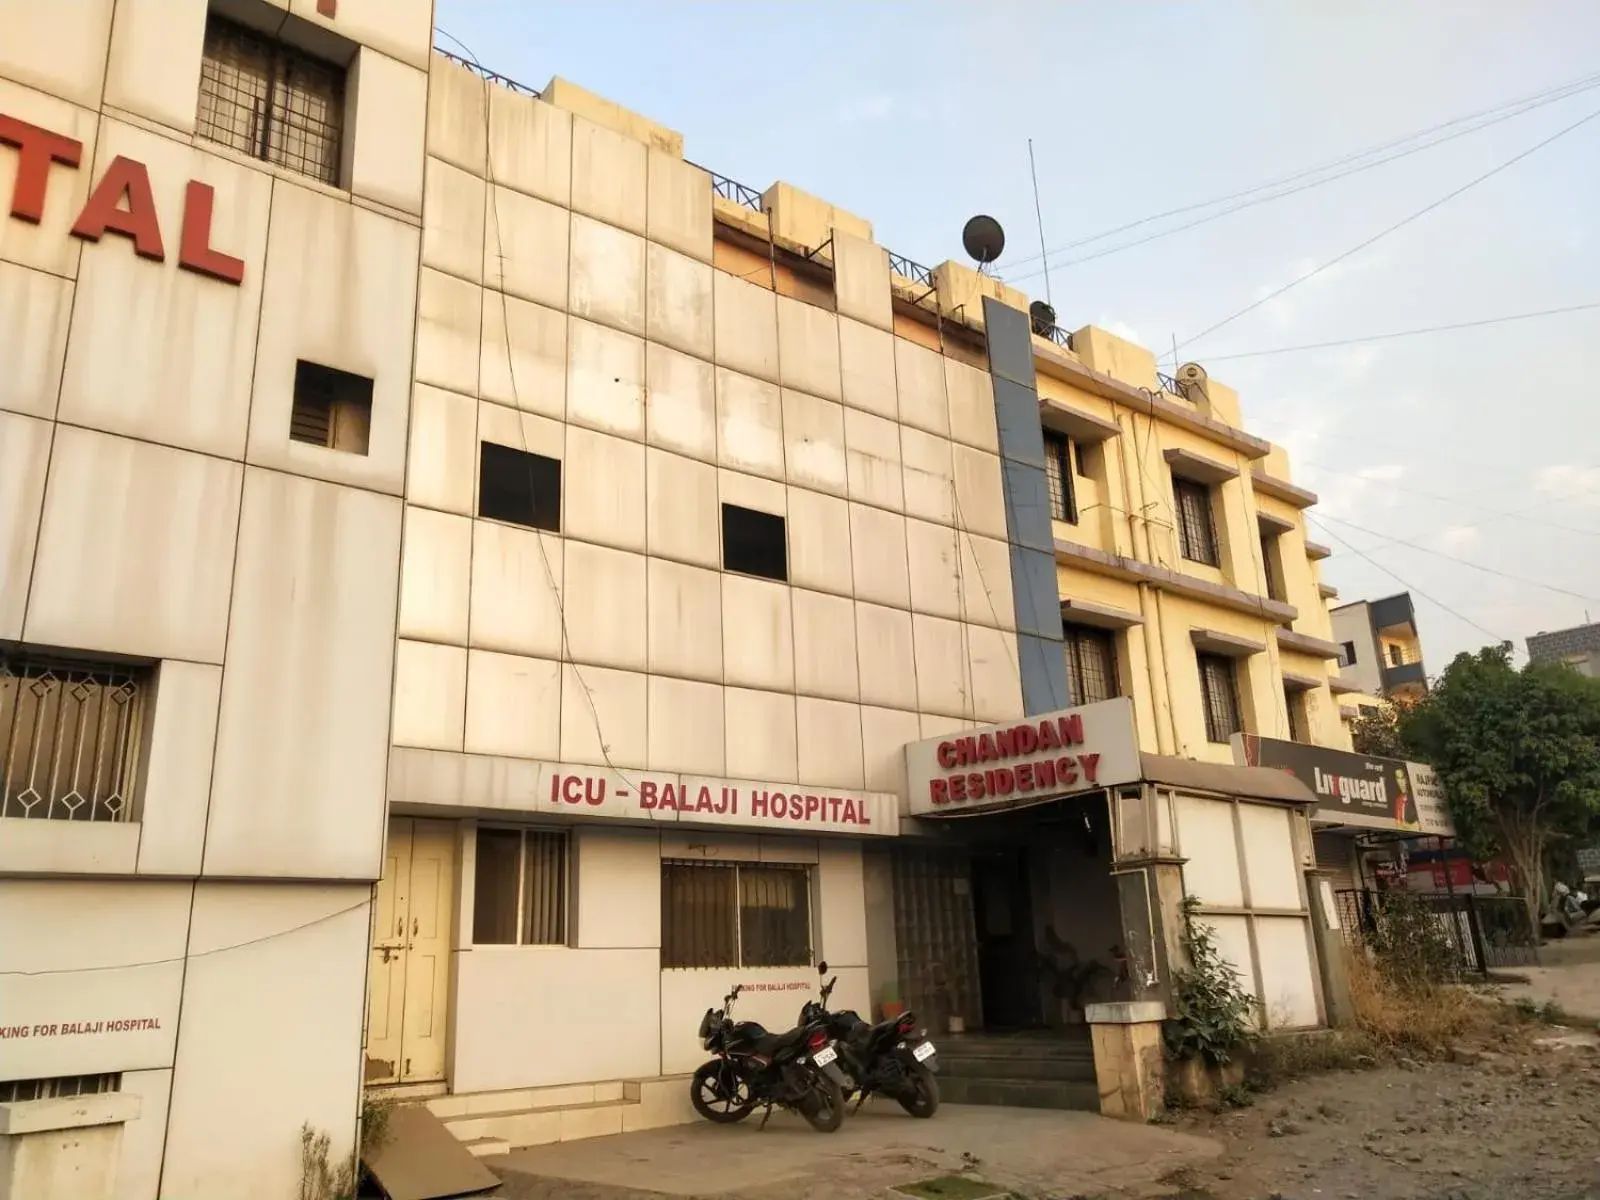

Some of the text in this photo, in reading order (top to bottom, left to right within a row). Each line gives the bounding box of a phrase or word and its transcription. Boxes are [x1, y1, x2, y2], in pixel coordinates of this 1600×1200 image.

[0, 113, 245, 286] TAL
[937, 714, 1084, 769] CHANDAN
[550, 774, 606, 805] ICU
[639, 781, 738, 815] BALAJI
[752, 790, 871, 825] HOSPITAL
[930, 753, 1100, 805] RESIDENCY
[33, 1024, 57, 1037] FOR
[61, 1021, 103, 1036] BALAJI
[106, 1018, 161, 1032] HOSPITAL
